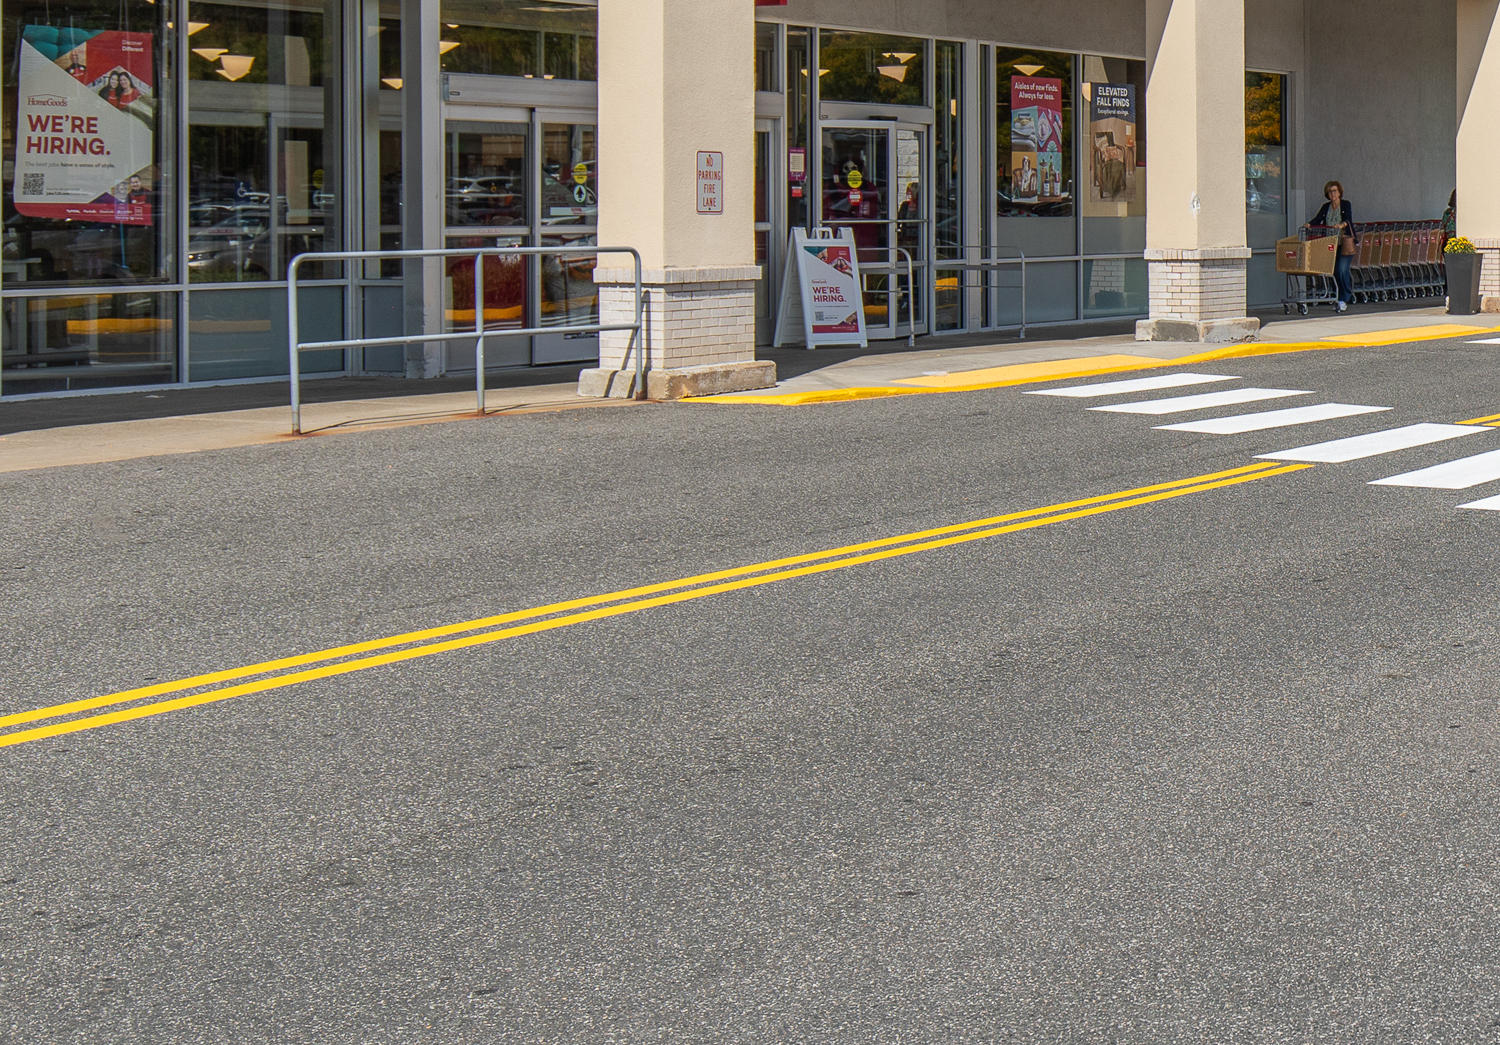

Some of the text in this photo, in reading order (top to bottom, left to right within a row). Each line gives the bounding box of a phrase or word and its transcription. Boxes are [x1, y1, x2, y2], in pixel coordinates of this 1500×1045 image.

[1014, 82, 1030, 90] Aisles
[1030, 82, 1036, 90] of
[1045, 83, 1059, 92] finds.
[1098, 86, 1128, 97] ELEVATED
[1018, 91, 1037, 101] Always
[1036, 92, 1044, 100] for
[27, 96, 68, 107] HomeGoods
[1096, 97, 1130, 108] FALL FINDS
[26, 114, 99, 134] WE'RE
[26, 136, 111, 156] HIRING.
[706, 157, 714, 167] NO
[698, 170, 722, 181] PARKING
[703, 184, 716, 194] FIRE
[702, 197, 717, 207] LANE
[812, 286, 841, 294] WE'RE
[813, 294, 847, 303] HIRING.
